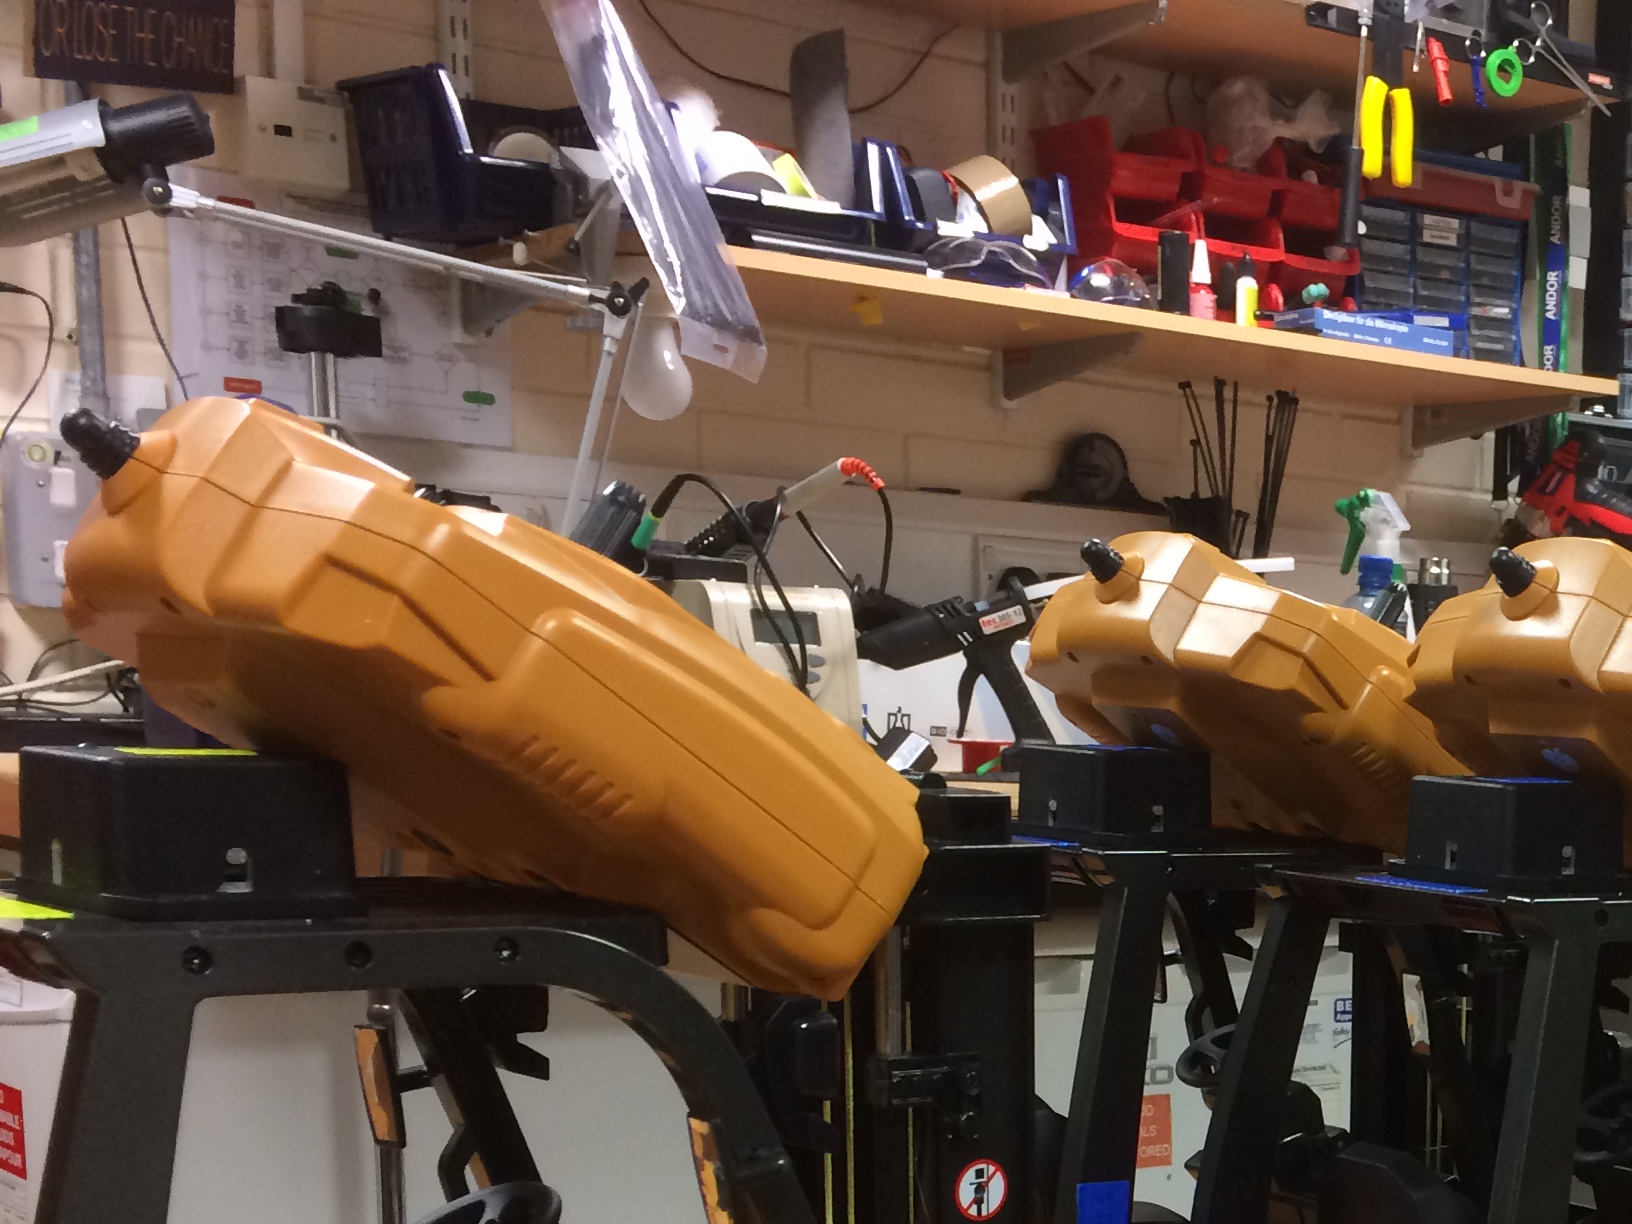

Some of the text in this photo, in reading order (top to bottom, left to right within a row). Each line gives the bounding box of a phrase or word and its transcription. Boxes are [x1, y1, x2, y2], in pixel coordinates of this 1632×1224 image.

[123, 6, 156, 67] THE
[1549, 194, 1563, 245] ANDOR
[1544, 270, 1560, 320] ANDOR
[1543, 344, 1555, 372] DOR
